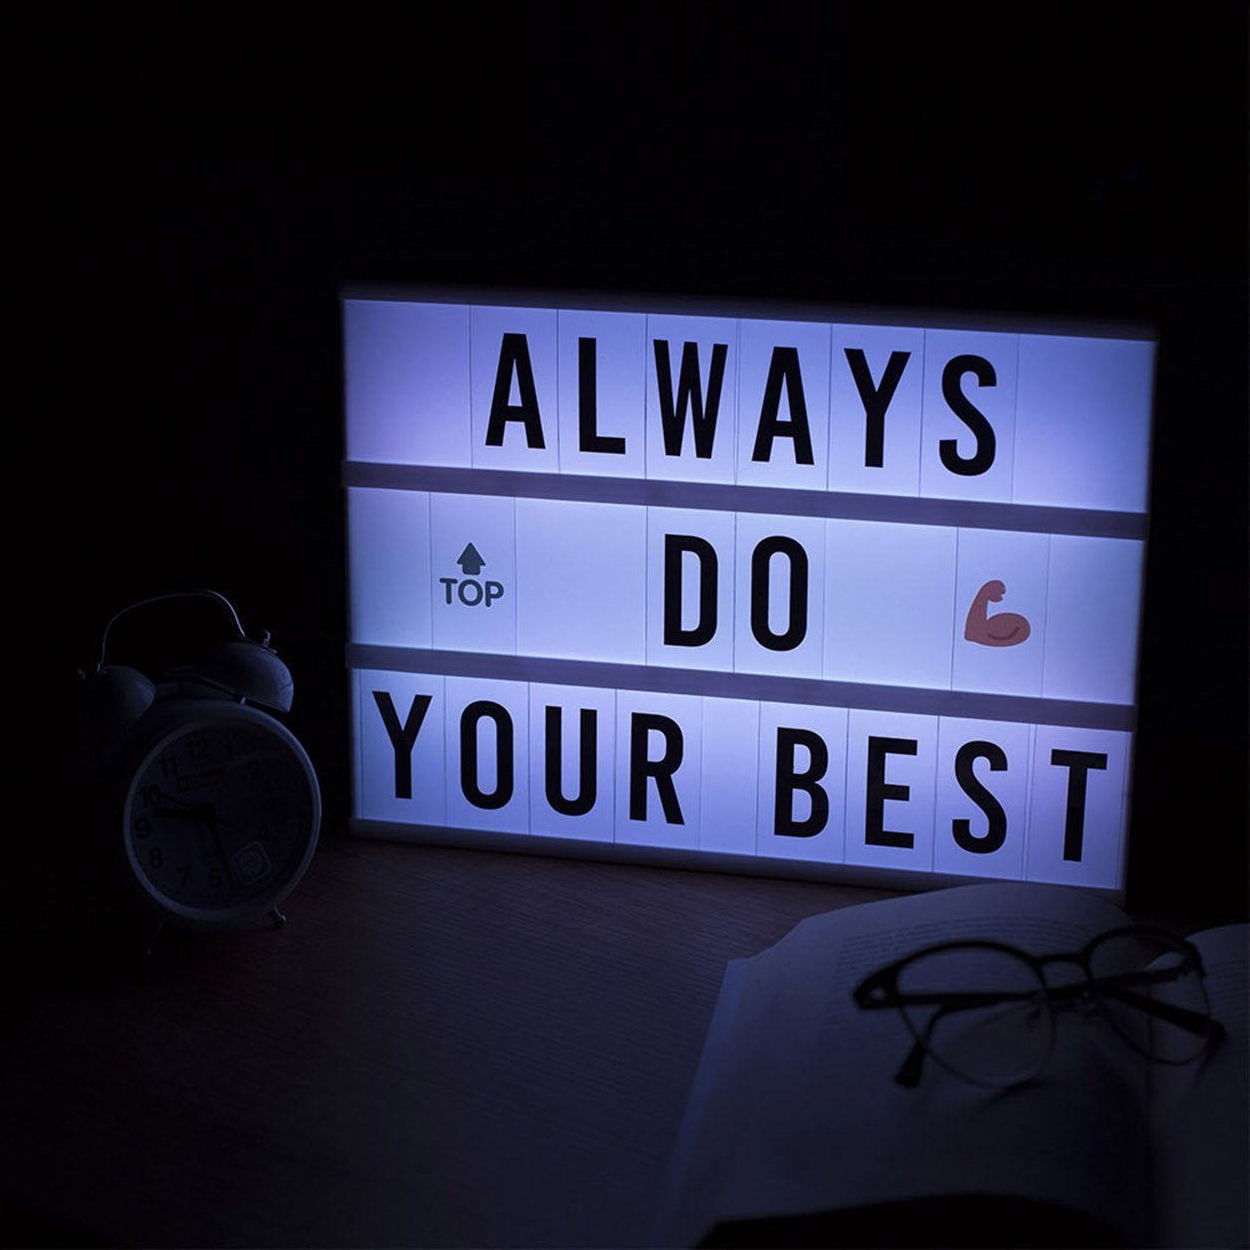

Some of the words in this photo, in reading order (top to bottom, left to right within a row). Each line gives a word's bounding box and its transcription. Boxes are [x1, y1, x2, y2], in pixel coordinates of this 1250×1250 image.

[485, 333, 997, 477] ALWAYS
[439, 578, 504, 607] TOP
[664, 534, 808, 651] DO
[188, 738, 210, 760] 12
[371, 691, 686, 826] YOUR
[774, 727, 1107, 862] BEST
[140, 785, 160, 807] 10
[134, 817, 150, 838] 9
[150, 848, 163, 869] 8
